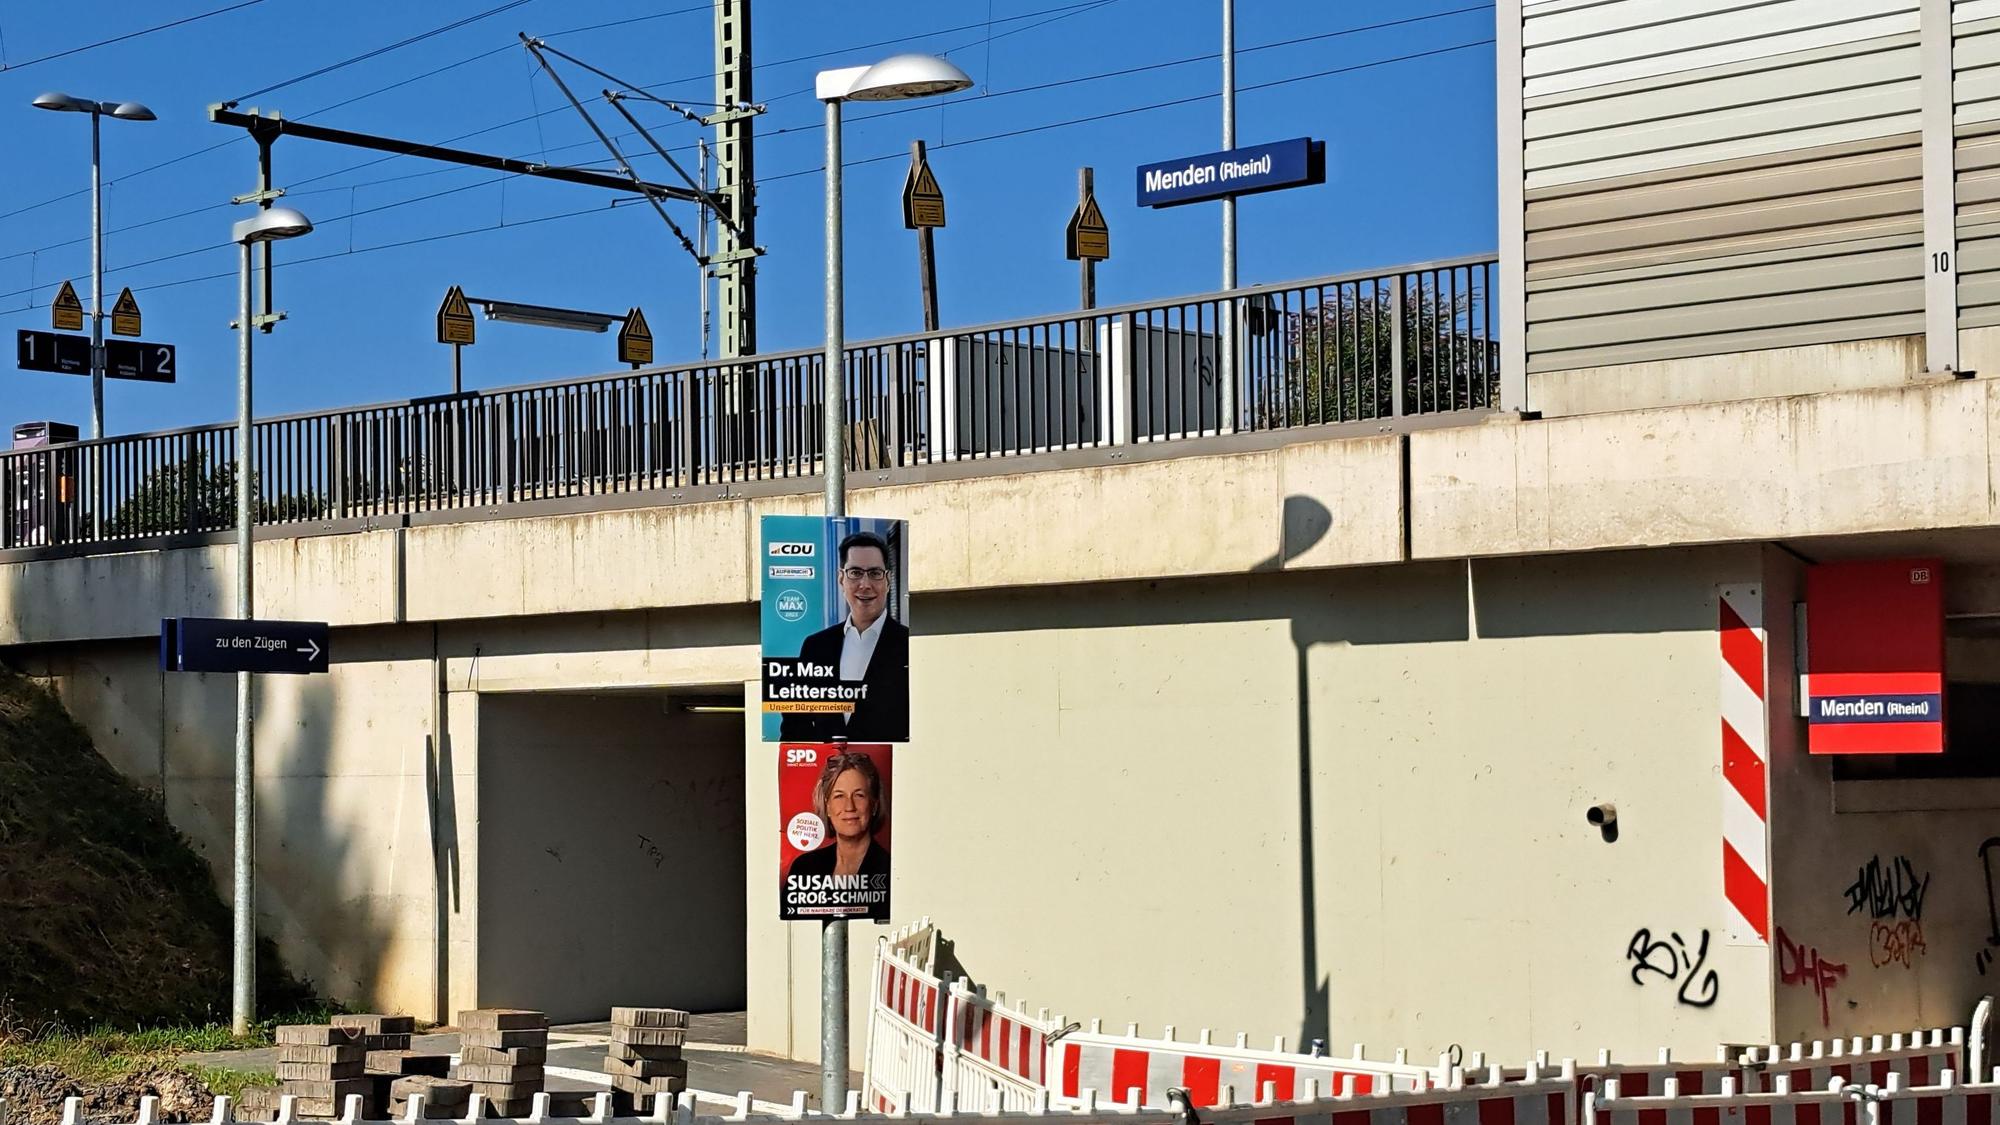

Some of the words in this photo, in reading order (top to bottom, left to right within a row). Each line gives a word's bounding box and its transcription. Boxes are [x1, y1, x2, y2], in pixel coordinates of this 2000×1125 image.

[1145, 164, 1216, 193] Menden
[1219, 154, 1271, 182] (Rheinl)
[1931, 251, 1949, 274] 10
[24, 334, 35, 361] 1
[156, 347, 171, 374] 2
[781, 544, 813, 555] CDU
[1912, 570, 1928, 581] DB
[779, 601, 803, 610] MAX
[215, 637, 229, 648] zu
[231, 636, 252, 648] den
[254, 636, 287, 651] Zügen
[769, 662, 794, 677] Dr.
[797, 662, 834, 677] Max
[769, 683, 868, 699] Leitterstorf
[769, 703, 793, 711] Unser
[1821, 699, 1884, 716] Menden
[1887, 701, 1929, 716] (Rheinl)
[786, 749, 817, 763] SPD
[796, 818, 819, 827] SOZIALE
[796, 824, 818, 832] POLITIK
[787, 874, 869, 891] SUSANNE
[787, 890, 887, 904] GROß-SCHMIDT
